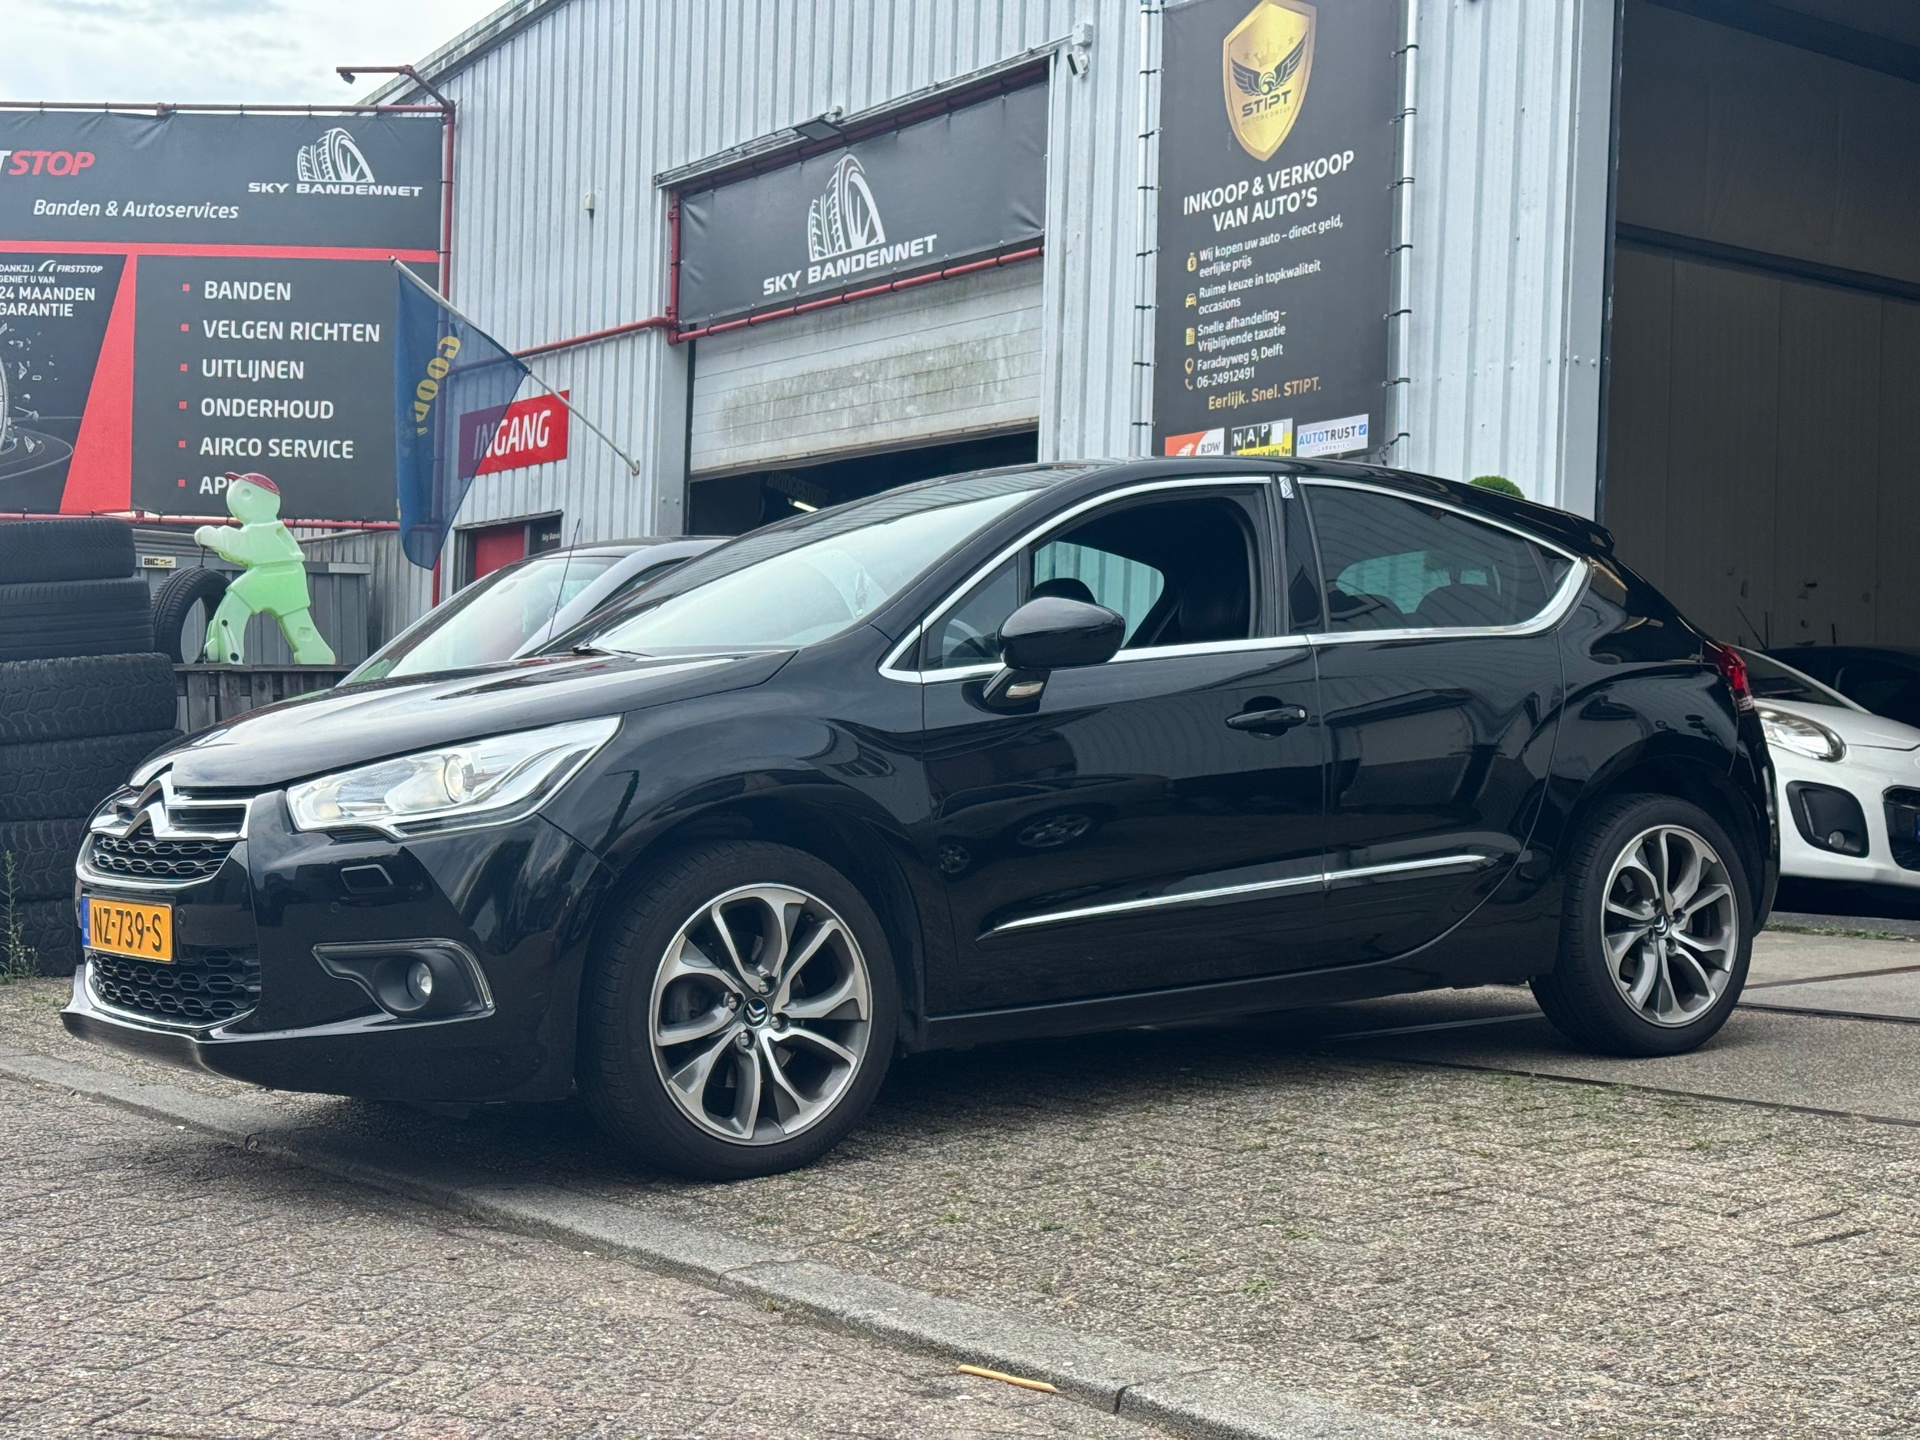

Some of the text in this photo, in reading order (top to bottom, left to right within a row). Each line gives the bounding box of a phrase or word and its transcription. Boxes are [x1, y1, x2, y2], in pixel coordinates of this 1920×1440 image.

[1242, 89, 1292, 118] STIPT
[248, 182, 423, 197] SKY BANDENNET
[1183, 150, 1354, 215] INKOOP & VERKOOP
[33, 199, 240, 219] Banden & Autoservices
[1213, 187, 1318, 232] VAN AUTO'S
[1199, 247, 1214, 261] Wij
[1215, 242, 1243, 258] kopen
[1244, 239, 1259, 250] uw
[1259, 233, 1280, 246] auto
[1288, 222, 1317, 239] direct
[1318, 214, 1343, 234] geld,
[0, 264, 104, 274] DANKZIJ FIRSTSTOP
[763, 234, 938, 296] SKY BANDENNET
[1199, 255, 1252, 277] eerlijke prijs
[0, 275, 56, 284] GENIET U VAN
[1199, 259, 1321, 298] Ruime keuze in topkwaliteit
[0, 286, 96, 301] 24 MAANDEN
[203, 280, 291, 301] BANDEN
[0, 302, 74, 317] GARANTIE
[1198, 297, 1241, 315] occasions
[203, 319, 381, 343] VELGEN RICHTEN
[1197, 320, 1224, 336] Snelle
[1225, 310, 1279, 330] afhandeling
[1197, 324, 1286, 352] Vrijblijvende taxatie
[1197, 343, 1284, 371] Faradayweg 9, Delft
[201, 358, 305, 381] UITLIJNEN
[1196, 366, 1255, 389] 06-24912491
[1208, 377, 1321, 410] Eerlijk. Snel. STIPT.
[200, 397, 335, 420] ONDERHOUD
[473, 409, 551, 461] INGANG
[1298, 425, 1357, 446] AUTOTRUST
[199, 437, 354, 459] AIRCO SERVICE
[1201, 441, 1221, 454] RDW
[93, 905, 162, 952] NZ-739-S
